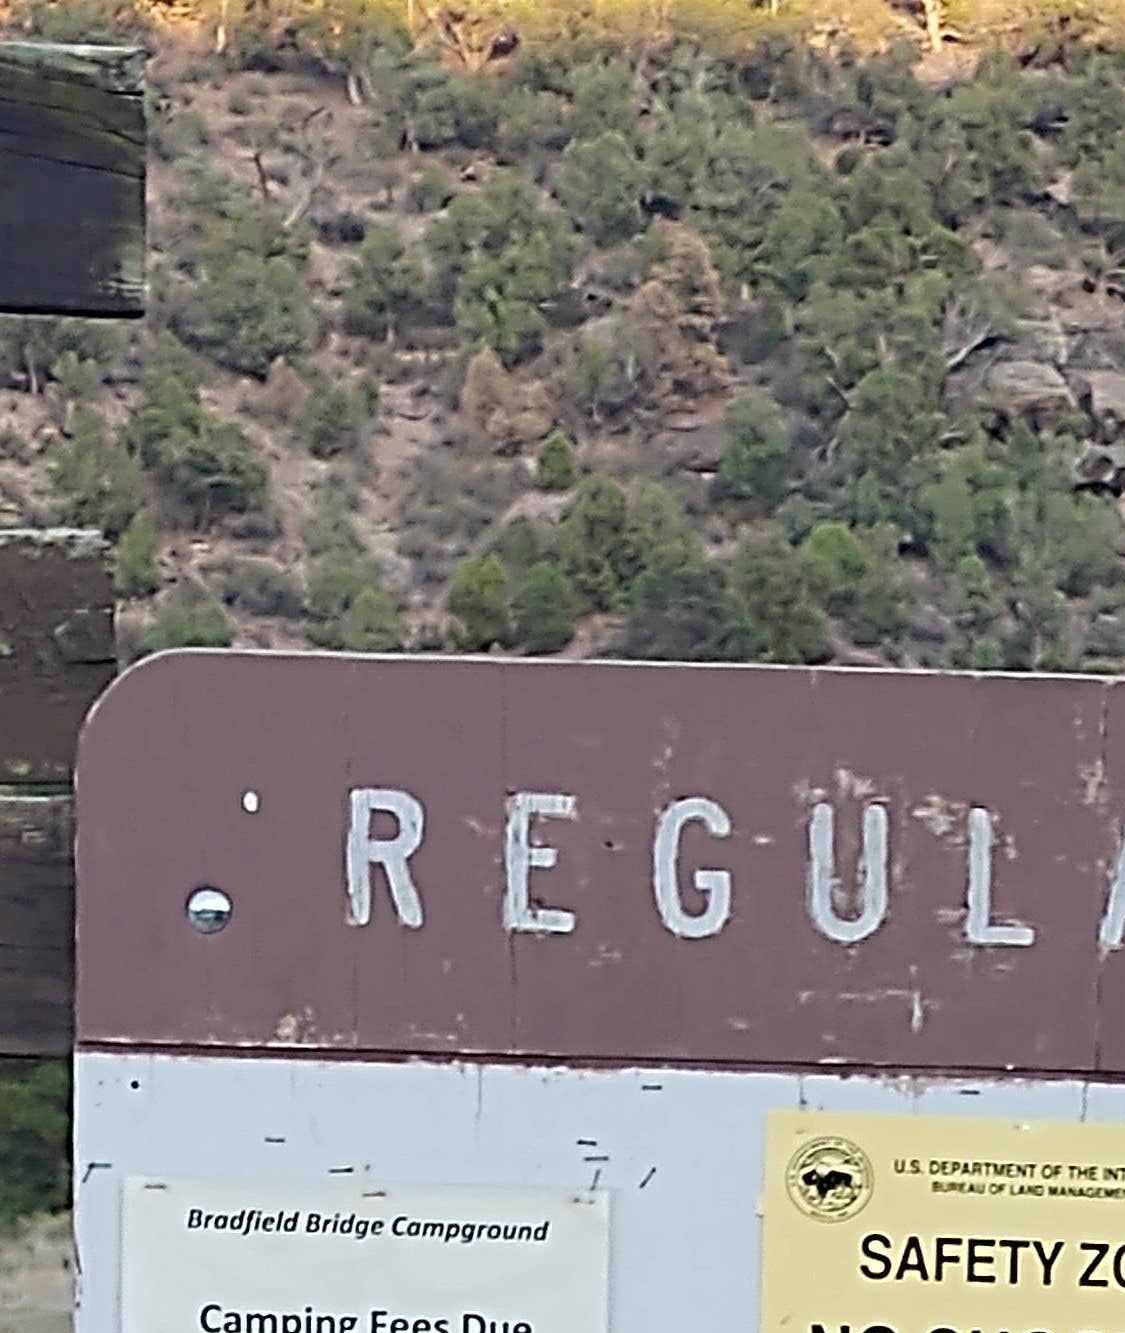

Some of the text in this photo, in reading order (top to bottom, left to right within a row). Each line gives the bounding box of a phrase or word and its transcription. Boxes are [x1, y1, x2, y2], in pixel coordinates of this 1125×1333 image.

[894, 1159, 922, 1174] U.S.
[929, 1160, 1036, 1179] DEPARTMENT
[1041, 1165, 1063, 1180] OF
[1068, 1166, 1098, 1181] THE
[931, 1181, 986, 1194] BUREAU
[989, 1183, 1006, 1195] OF
[1009, 1183, 1044, 1196] LAND
[186, 1208, 549, 1244] Bradfield Bridge Campground
[859, 1234, 1065, 1286] SAFETY
